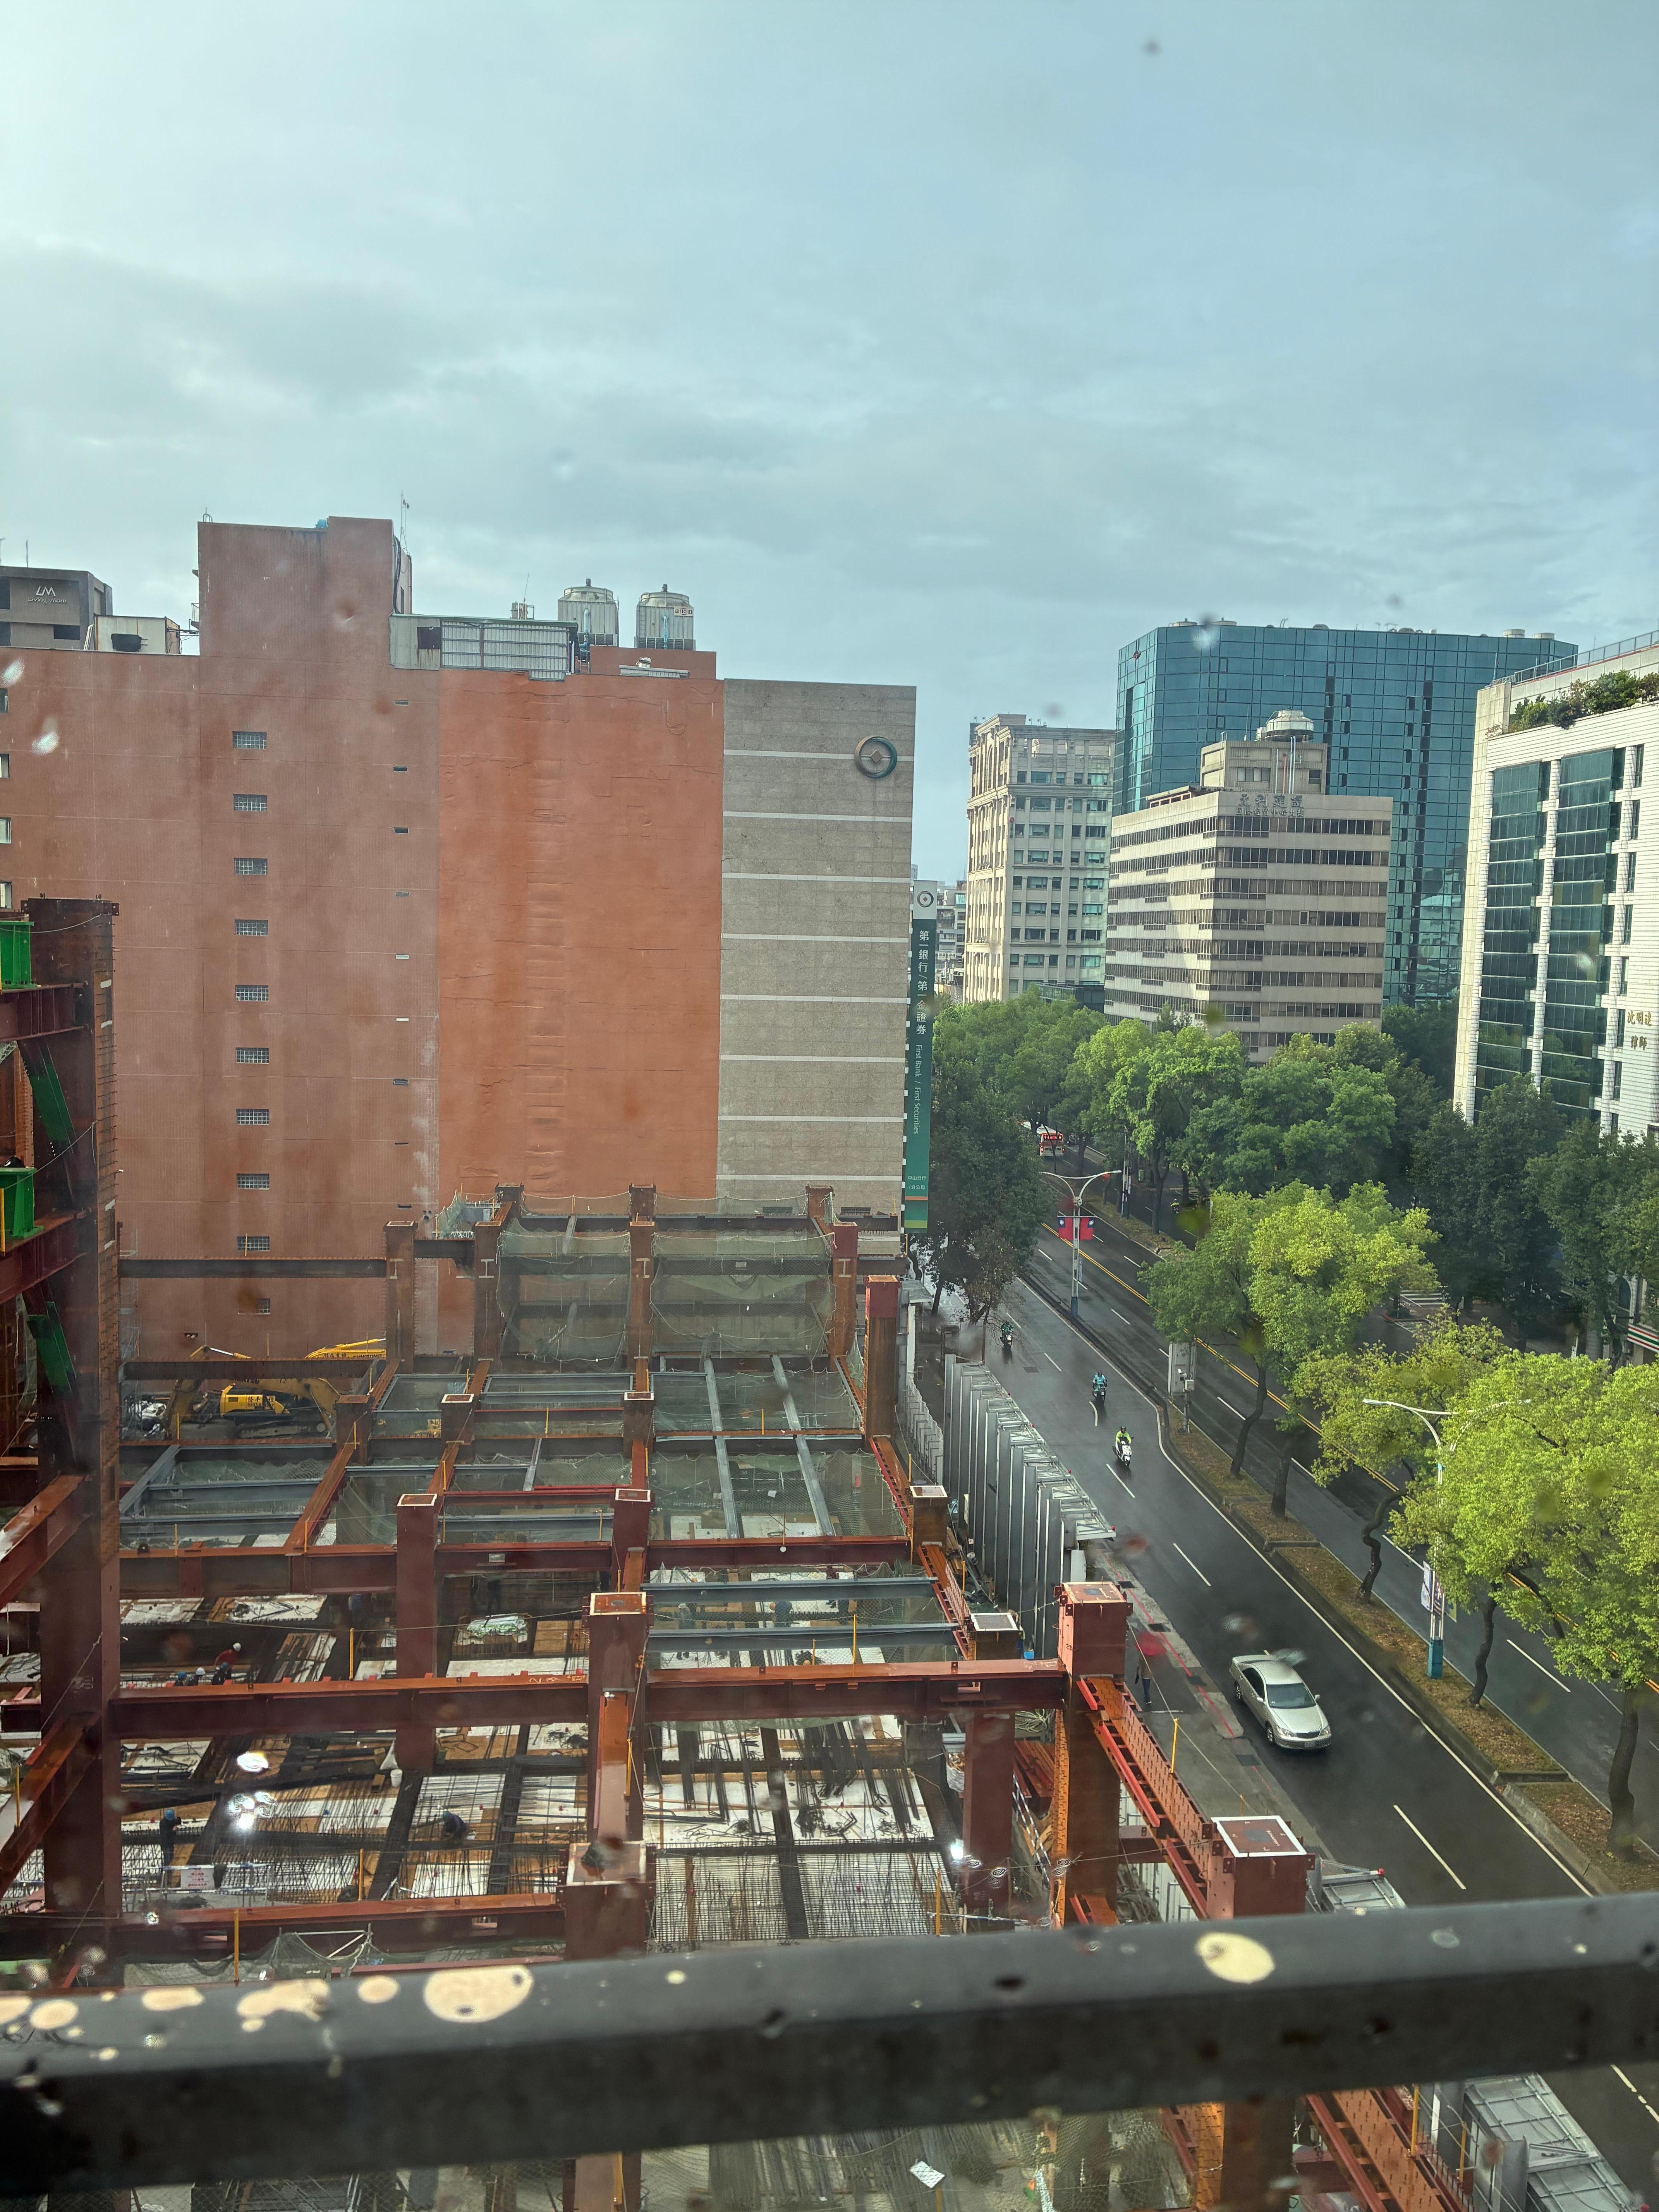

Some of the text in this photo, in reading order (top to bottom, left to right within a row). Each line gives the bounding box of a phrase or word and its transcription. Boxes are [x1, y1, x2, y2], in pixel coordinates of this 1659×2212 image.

[916, 930, 929, 1035] 第一銀行/第一金證券
